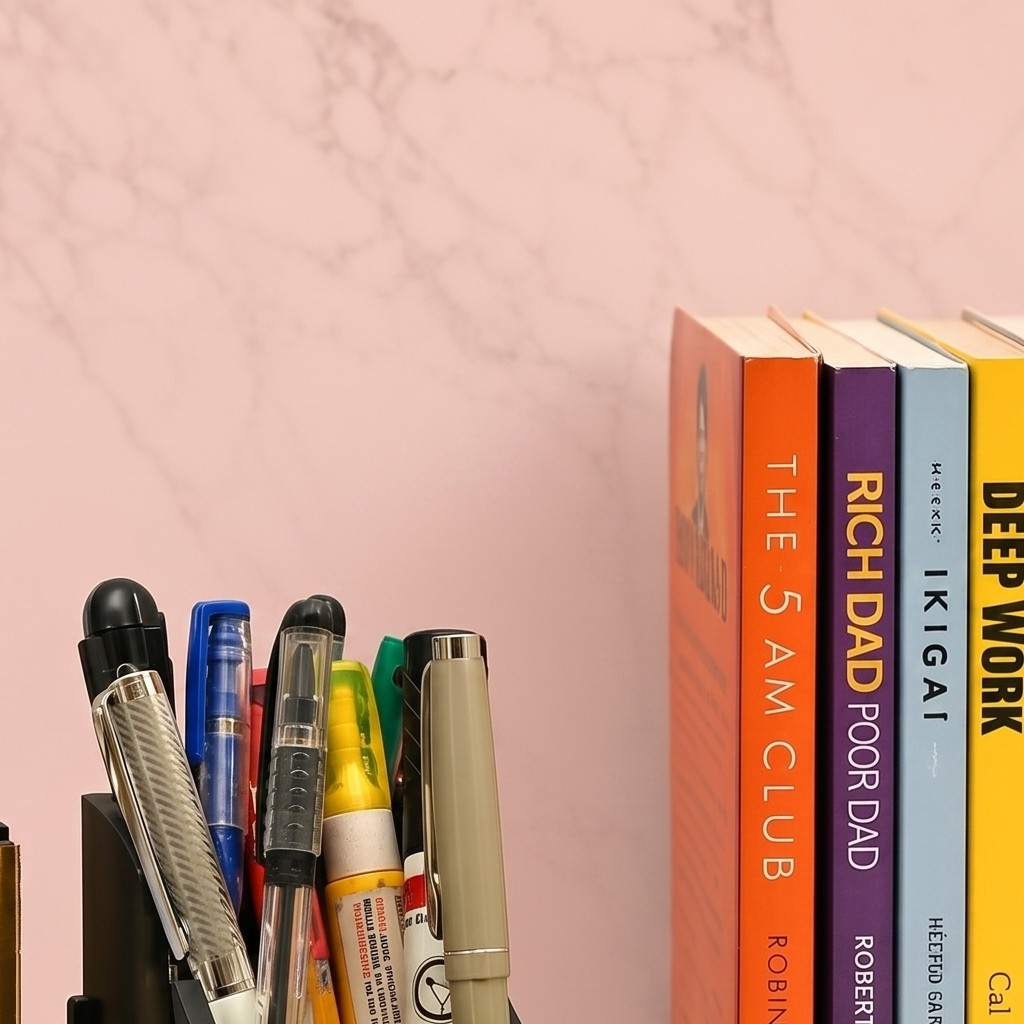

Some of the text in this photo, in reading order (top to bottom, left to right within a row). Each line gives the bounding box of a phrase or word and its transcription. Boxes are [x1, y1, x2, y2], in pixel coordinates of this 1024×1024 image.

[759, 455, 801, 879] THE 5 AM CLUB
[847, 473, 883, 869] RICH DAD POOR DAD
[980, 481, 1024, 736] DEEP WORK
[989, 972, 1011, 1015] Cal
